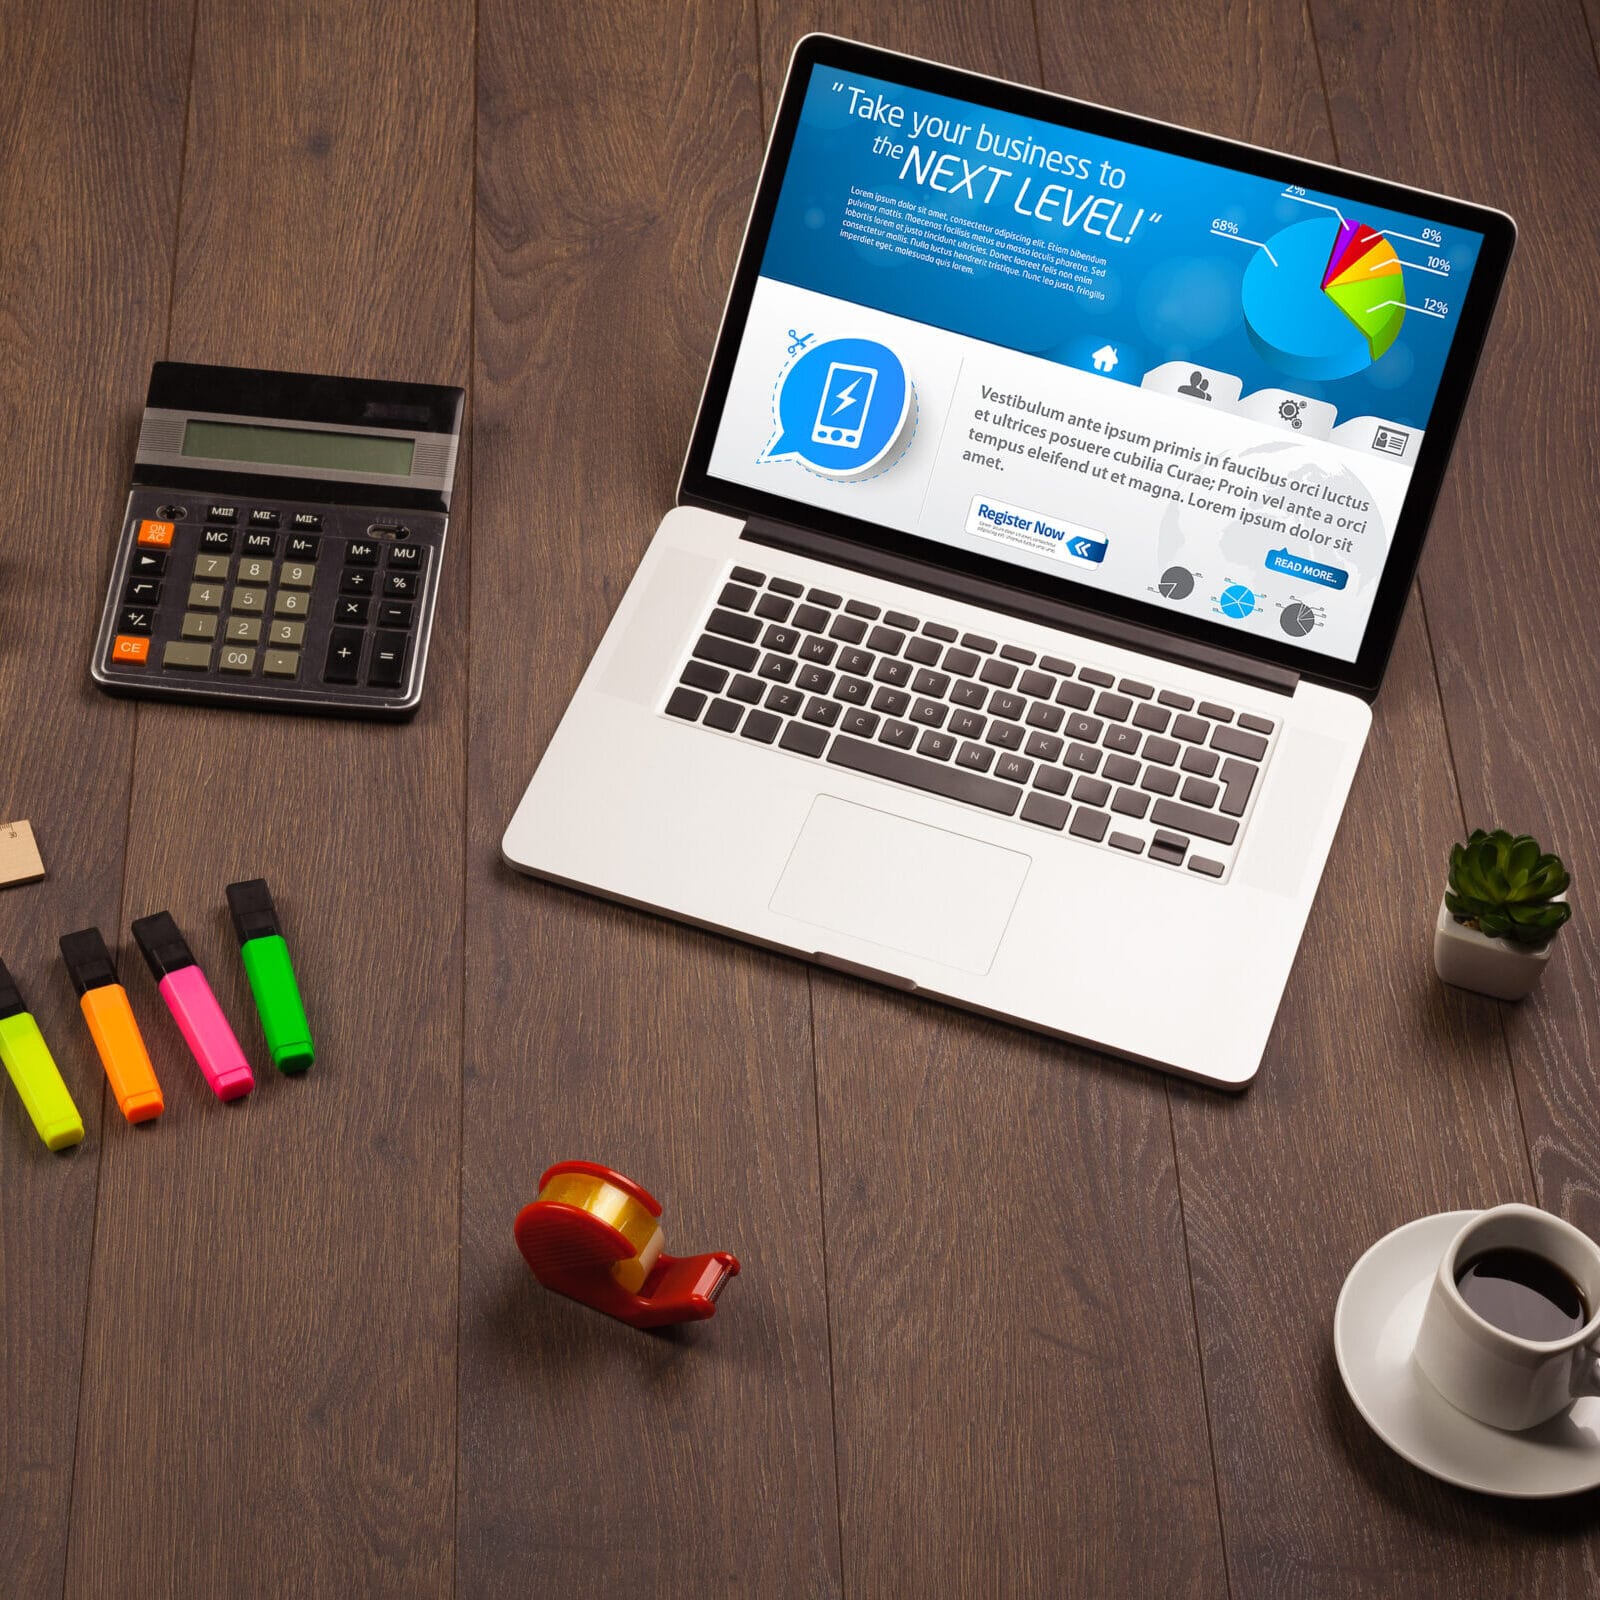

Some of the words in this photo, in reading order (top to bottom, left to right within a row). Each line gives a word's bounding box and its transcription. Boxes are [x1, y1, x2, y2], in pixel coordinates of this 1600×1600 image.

[908, 110, 971, 145] your
[976, 123, 1090, 180] business
[1099, 160, 1126, 189] to
[872, 135, 903, 161] the
[899, 146, 1012, 204] NEXT
[1212, 218, 1239, 234] 68%
[1421, 228, 1441, 243] 8%
[1427, 256, 1450, 272] 10%
[1423, 298, 1448, 314] 12%
[981, 384, 1064, 422] Vestibulum
[1067, 414, 1101, 432] ante
[1103, 421, 1150, 447] ipsum
[1152, 439, 1201, 462] primis
[1203, 451, 1218, 467] in
[1221, 456, 1287, 487] faucibus
[1289, 480, 1320, 497] orci
[1321, 486, 1369, 511] luctus
[962, 450, 1003, 471] amet.
[974, 409, 990, 422] et
[992, 413, 1047, 438] ultrices
[1048, 431, 1110, 457] posuere
[1113, 451, 1163, 473] cubilia
[1166, 463, 1215, 490] Curae;
[1217, 478, 1258, 502] Proin
[1262, 494, 1285, 509] vel
[1286, 502, 1321, 520] ante
[1323, 513, 1333, 524] a
[1336, 517, 1367, 533] orci
[968, 427, 1024, 454] tempus
[1027, 445, 1090, 473] eleifend
[1091, 466, 1108, 479] ut
[1110, 472, 1126, 485] et
[1128, 477, 1183, 502] magna.
[1187, 491, 1236, 518] Lorem
[1239, 507, 1286, 533] ipsum
[1289, 523, 1332, 545] dolor
[1332, 537, 1353, 552] sit
[977, 503, 1032, 530] Register
[1033, 520, 1065, 540] Now
[150, 524, 166, 532] ON
[148, 533, 166, 542] AC
[206, 532, 228, 542] MC
[249, 536, 270, 546] MR
[293, 540, 312, 550] M-
[352, 545, 371, 555] M+
[394, 548, 415, 558] MU
[208, 560, 217, 572] 7
[1274, 556, 1302, 571] READ
[249, 564, 260, 575] 8
[292, 568, 302, 579] 9
[201, 590, 210, 600] 4
[243, 593, 253, 604] 5
[287, 597, 297, 608] 6
[238, 623, 249, 635] 2
[281, 627, 292, 638] 3
[776, 634, 785, 643] Q
[121, 642, 141, 653] CE
[813, 644, 824, 654] W
[228, 653, 247, 664] 00
[852, 656, 860, 665] E
[772, 663, 782, 672] A
[889, 667, 898, 676] R
[811, 674, 819, 683] S
[928, 678, 935, 686] T
[849, 685, 857, 694] D
[965, 689, 973, 697] Y
[780, 695, 789, 704] Z
[887, 697, 895, 705] F
[817, 706, 827, 716] X
[924, 707, 933, 716] G
[856, 718, 865, 726] C
[962, 719, 972, 728] H
[1079, 723, 1088, 731] O
[895, 729, 903, 738] V
[1002, 730, 1009, 739] J
[1119, 733, 1127, 742] P
[932, 740, 941, 749] B
[1039, 741, 1049, 750] K
[970, 751, 980, 760] N
[1007, 763, 1019, 772] M
